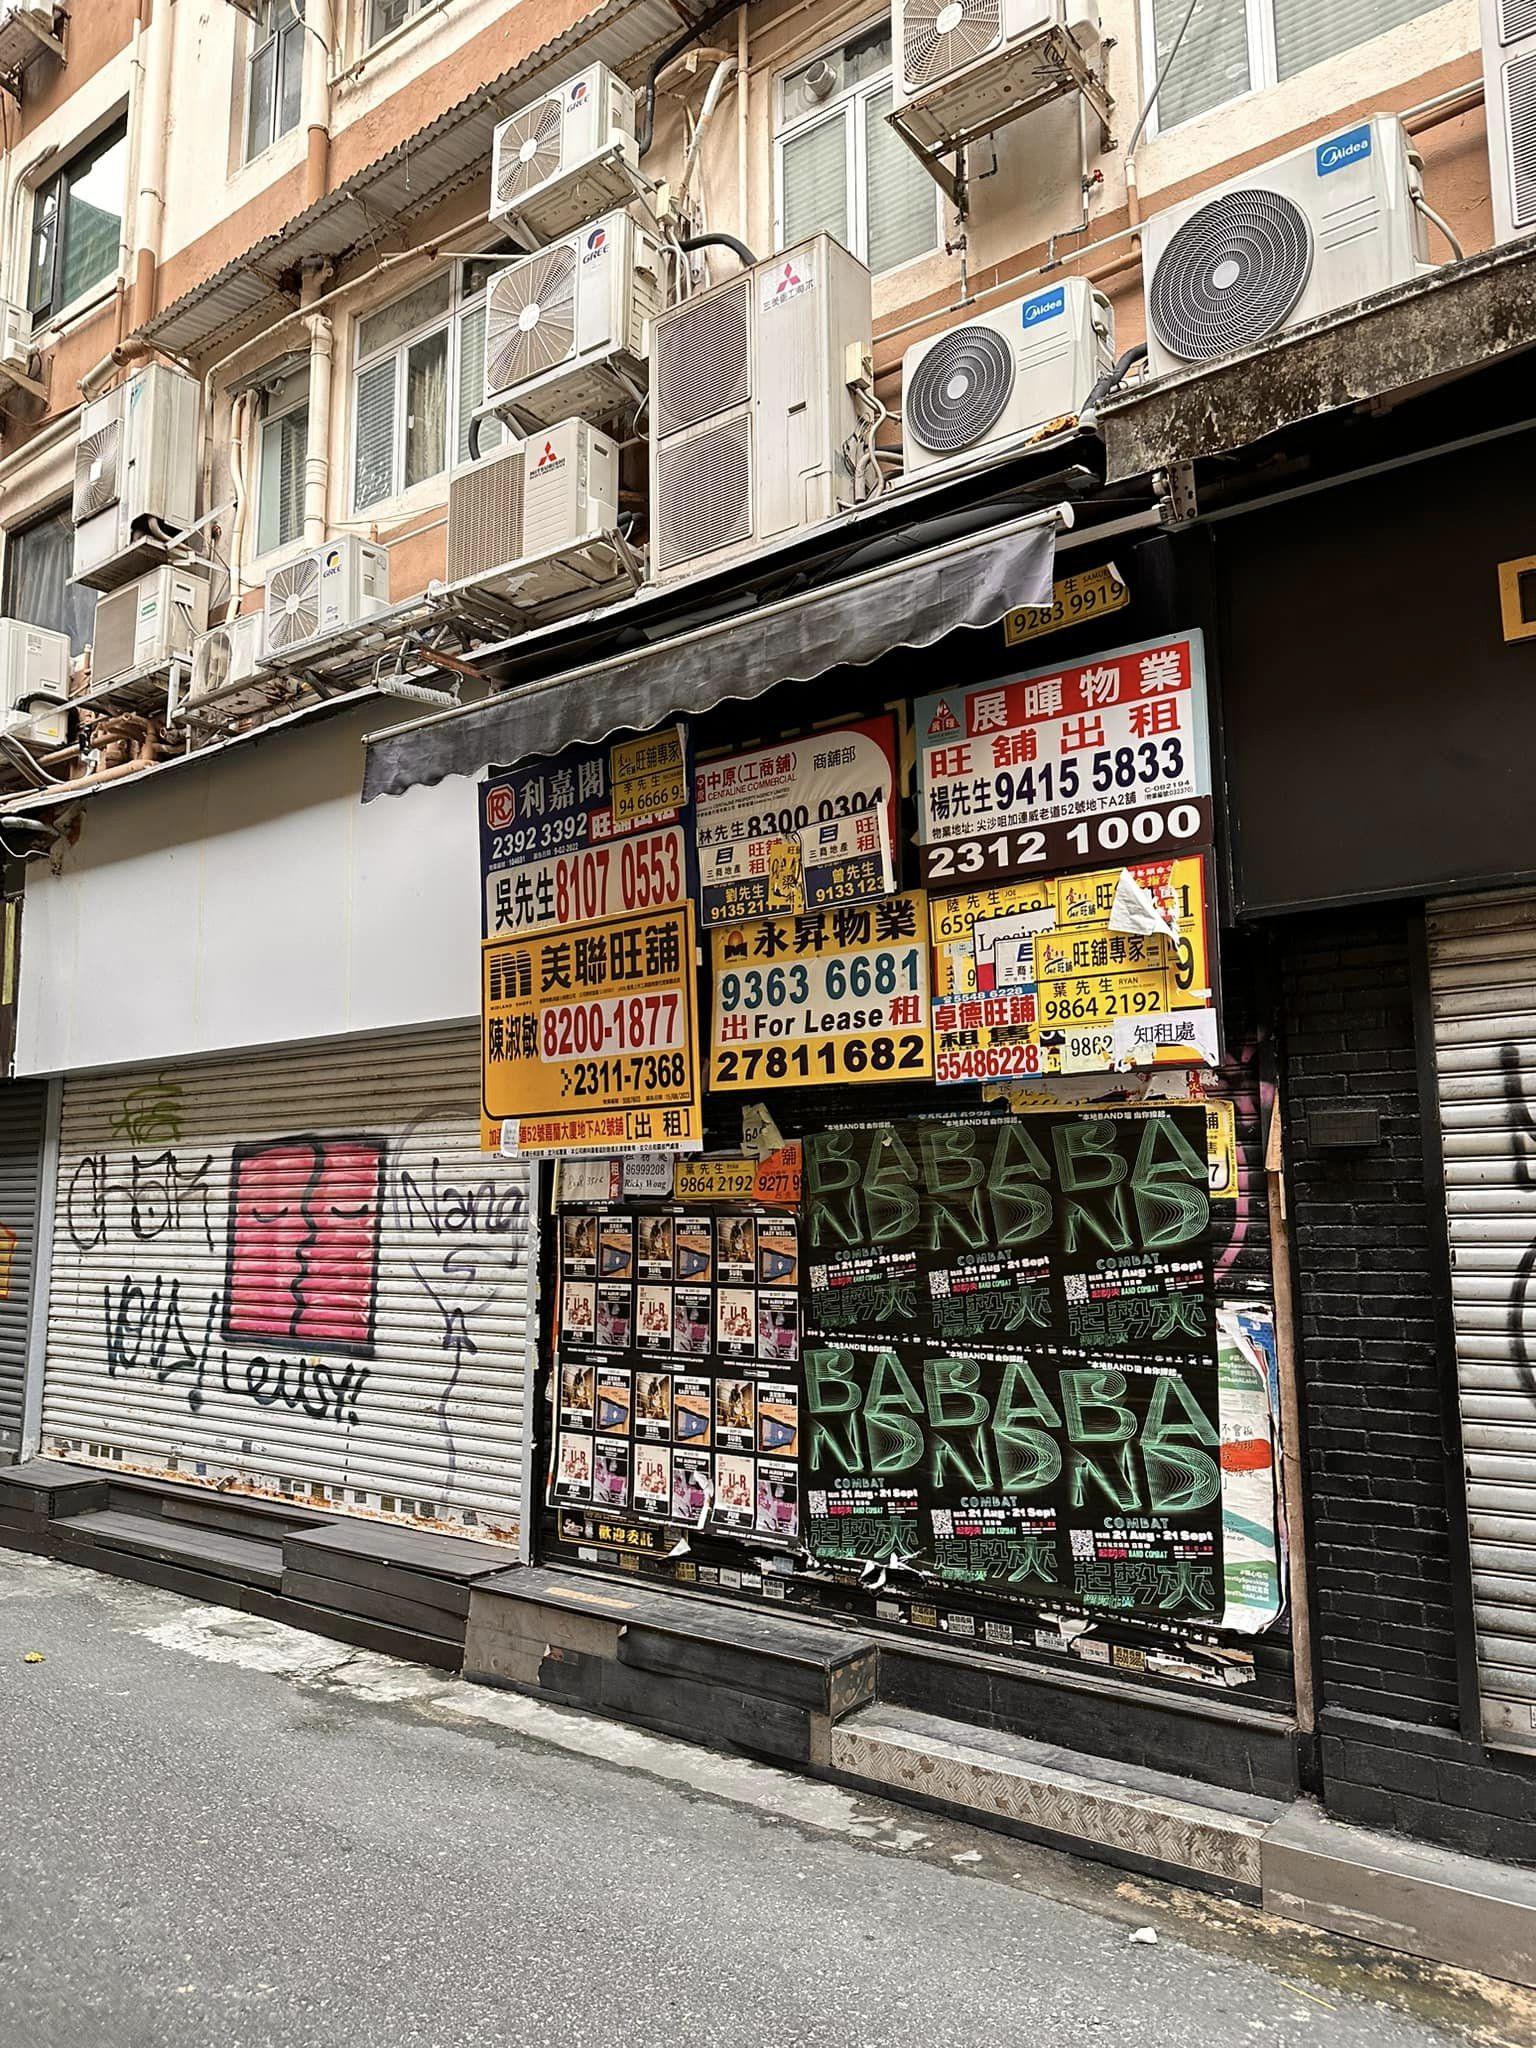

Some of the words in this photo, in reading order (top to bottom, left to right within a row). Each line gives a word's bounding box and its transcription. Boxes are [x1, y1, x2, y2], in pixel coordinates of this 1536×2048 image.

[1320, 138, 1369, 167] Midea
[583, 244, 610, 265] GREE
[1024, 298, 1062, 320] Midea
[1014, 601, 1064, 634] 9283
[1070, 580, 1124, 614] 9919
[972, 649, 1182, 733] 展暉物業
[930, 697, 1182, 779] 旺舖出租
[813, 745, 856, 772] 商舖部
[520, 758, 605, 818] 利嘉閣
[708, 785, 746, 801] CENTALINE
[748, 773, 797, 792] COMMERCIAL
[929, 777, 993, 821] 楊先生
[995, 757, 1080, 810] 9415
[1092, 737, 1184, 791] 5833
[637, 788, 669, 809] 6666
[492, 827, 536, 860] 2392
[540, 812, 588, 847] 3392
[699, 820, 745, 846] 林先生
[748, 805, 809, 837] 8300
[927, 831, 1047, 878] 2312
[1066, 804, 1200, 855] 1000
[495, 867, 556, 931] 吳先生
[556, 849, 610, 924] 8107
[621, 832, 681, 910] 0553
[816, 882, 855, 902] 9133
[1004, 889, 1017, 897] JOE
[711, 902, 745, 920] 9135
[753, 899, 917, 958] 永昇物業
[540, 922, 680, 993] 美聯旺舖
[1073, 934, 1146, 968] 旺舖專家
[722, 964, 809, 1012] 9363
[825, 948, 920, 1000] 6681
[954, 991, 986, 1002] 5548
[989, 986, 1023, 998] 6228
[1053, 977, 1114, 998] 葉先生
[1118, 977, 1138, 985] RYAN
[721, 1014, 748, 1042] 出
[754, 1014, 795, 1038] For
[804, 1008, 883, 1034] Lease
[888, 994, 922, 1026] 租
[935, 994, 1036, 1032] 卓德旺舖
[1045, 997, 1099, 1021] 9864
[1105, 991, 1161, 1016] 2192
[488, 1012, 539, 1064] 陳淑敏
[543, 993, 678, 1058] 8200-1877
[1133, 1021, 1196, 1046] 知租處
[716, 1034, 924, 1082] 27811682
[936, 1044, 1039, 1081] 55486228
[574, 1052, 686, 1097] 2311-7368
[680, 1176, 714, 1193] 9864
[718, 1175, 753, 1192] 2192
[758, 1175, 789, 1191] 9277
[835, 1246, 884, 1261] COMBAT
[957, 1249, 1012, 1266] COMBAT
[1096, 1252, 1159, 1270] COMBAT
[834, 1478, 885, 1489] COMBAT
[960, 1496, 1018, 1508] COMBAT
[1103, 1517, 1169, 1529] COMBAT
